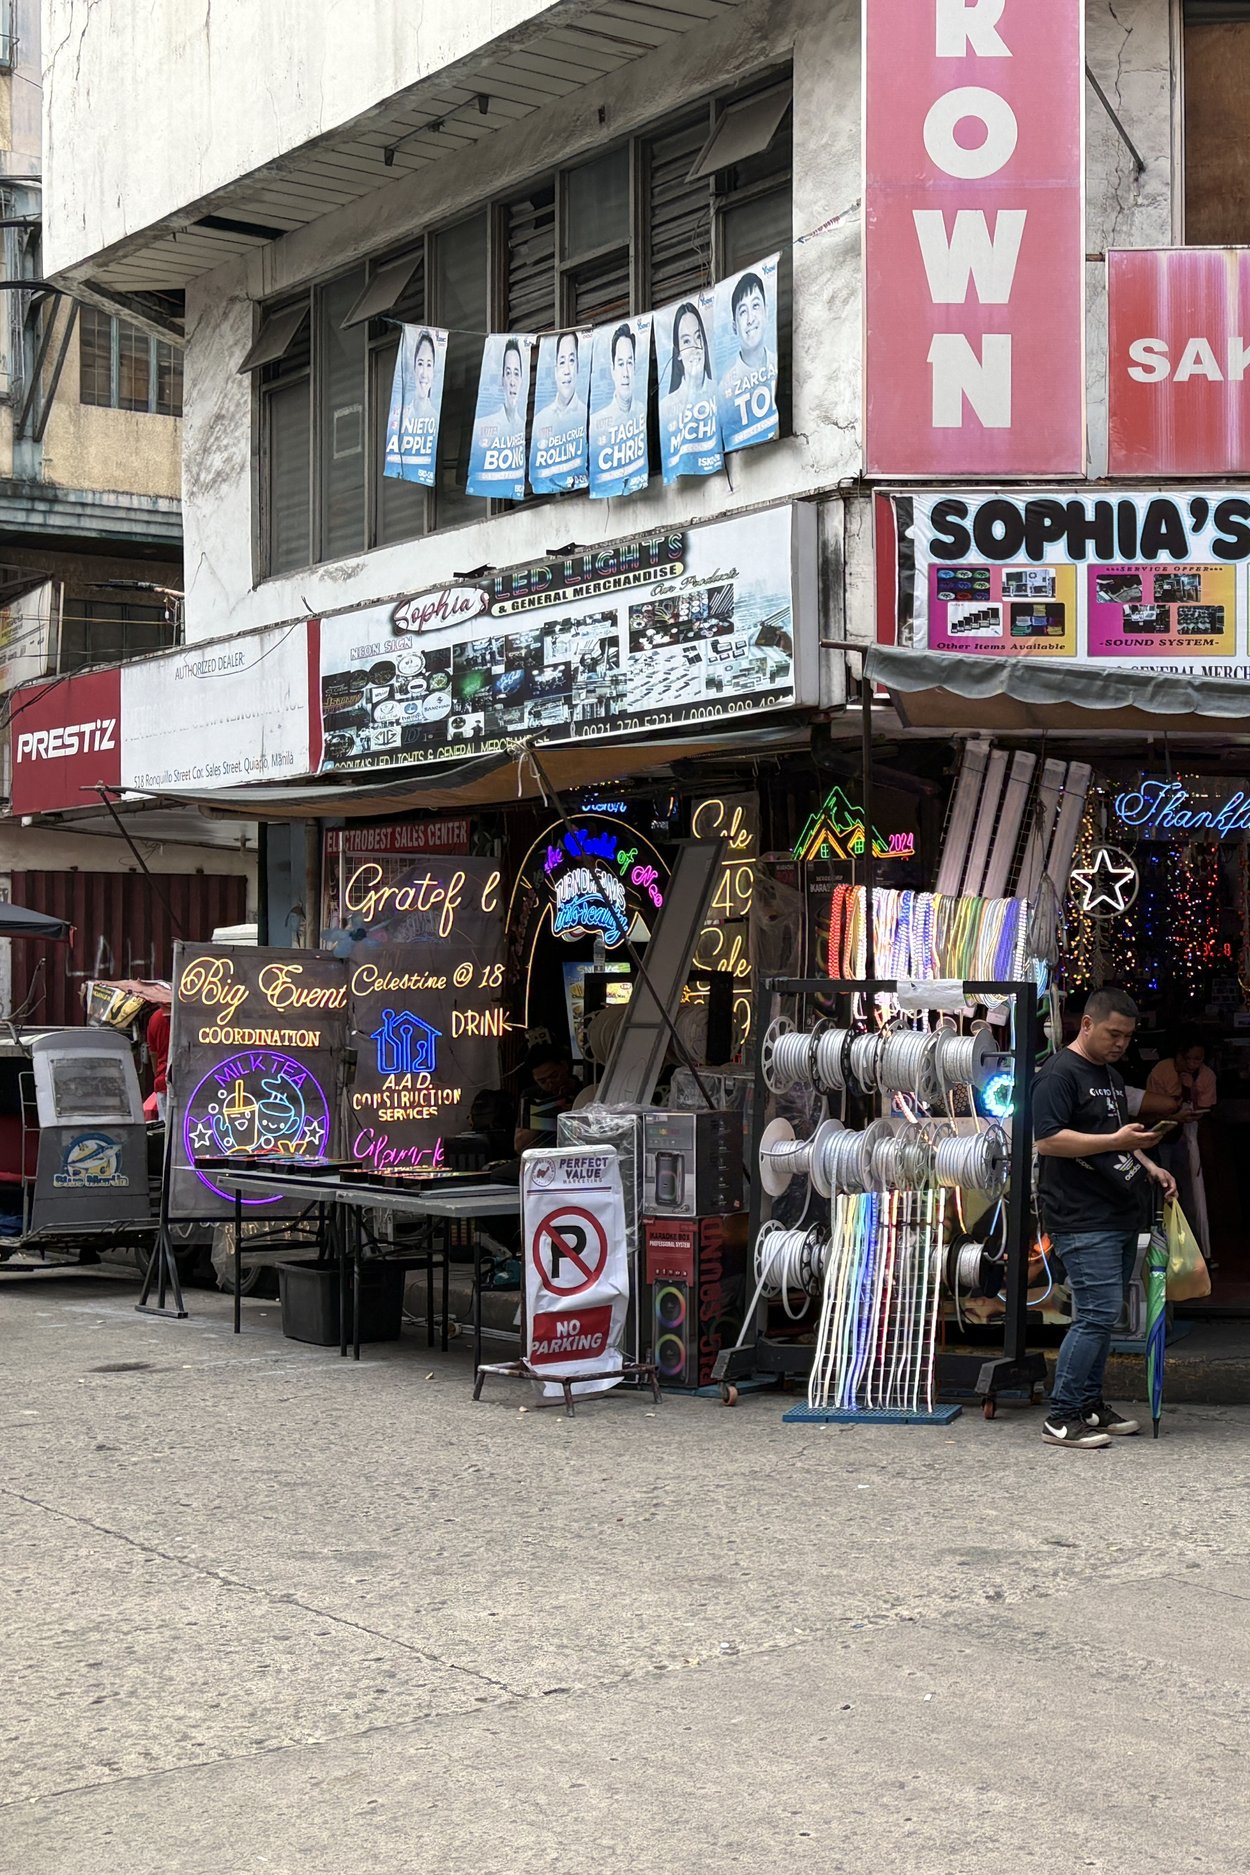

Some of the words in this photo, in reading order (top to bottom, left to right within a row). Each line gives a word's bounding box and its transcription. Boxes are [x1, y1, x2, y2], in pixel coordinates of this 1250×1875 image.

[386, 434, 433, 455] APPLE
[598, 435, 644, 471] CHRIS
[483, 446, 524, 470] BONG
[494, 565, 552, 600] LED
[563, 531, 686, 584] LIGHTS
[498, 604, 507, 614] &
[511, 588, 569, 612] GENERAL
[573, 563, 678, 598] MERCHANDISE
[392, 588, 490, 636] Sophia's
[349, 643, 382, 661] NEON
[384, 636, 413, 653] SIGN
[937, 642, 971, 651] Other
[974, 643, 1006, 651] Items
[1010, 642, 1066, 651] Available
[175, 657, 217, 681] AUTHORIZED
[205, 763, 222, 777] Sales
[271, 752, 294, 768] Manila
[326, 827, 393, 853] ELCTROBEST
[394, 824, 426, 848] SALES
[427, 819, 468, 846] CENTER
[888, 832, 915, 853] 2024
[345, 862, 501, 938] Gratefl
[178, 956, 249, 1025] Big
[351, 963, 447, 997] Celestine
[453, 961, 473, 988] @
[477, 963, 506, 989] 18
[198, 1026, 321, 1048] COORDINATION
[214, 1055, 266, 1088] MILK
[270, 1055, 307, 1088] TEA
[353, 1087, 462, 1110] CONSTRUCTION
[378, 1106, 438, 1121] SERVICES
[559, 1157, 609, 1169] PERFECT
[565, 1168, 602, 1179] VALUE
[53, 1173, 85, 1188] Blue
[86, 1172, 130, 1188] Marlin
[678, 1231, 690, 1241] BOX
[556, 1319, 581, 1335] NO
[532, 1332, 603, 1355] PARKING
